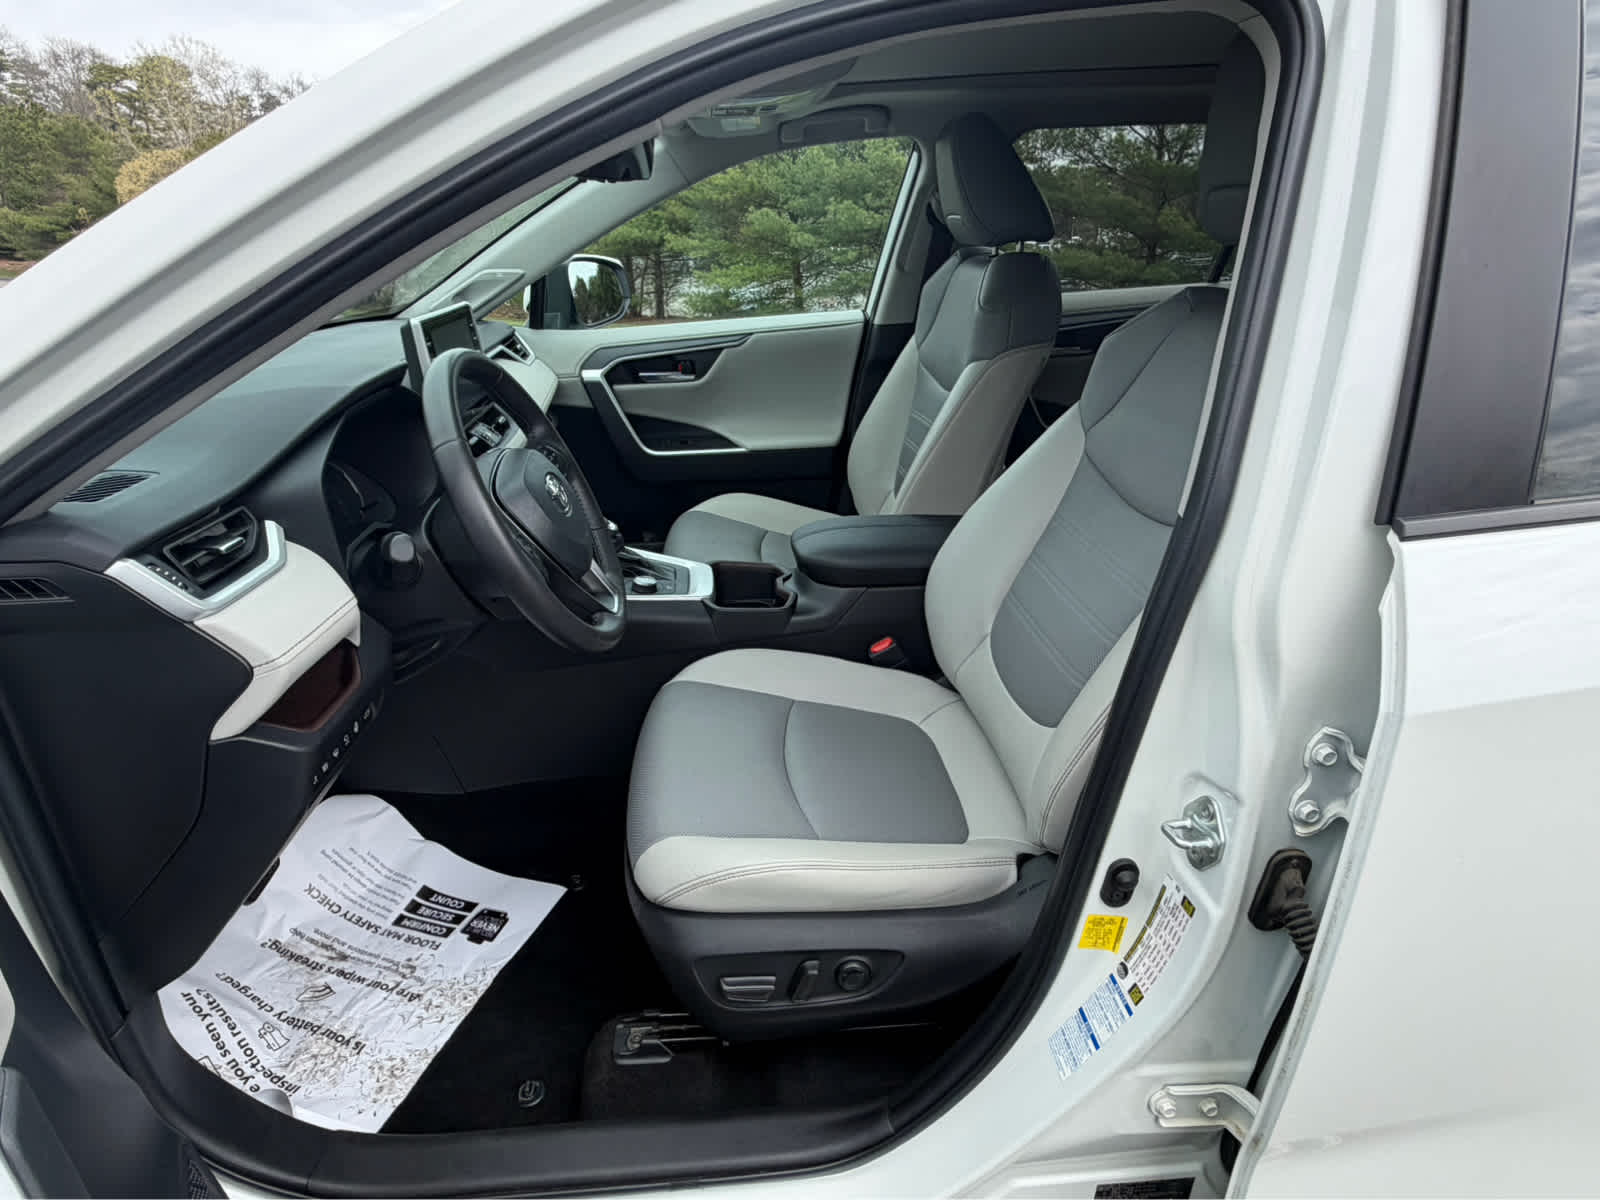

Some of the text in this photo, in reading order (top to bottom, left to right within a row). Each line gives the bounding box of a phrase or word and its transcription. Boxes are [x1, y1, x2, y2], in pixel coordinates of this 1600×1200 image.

[303, 883, 342, 914] CHECK
[429, 892, 465, 909] COUNT
[339, 910, 382, 934] SAFETY
[416, 905, 455, 922] SECURE
[379, 928, 404, 943] MAT
[400, 917, 448, 936] CONFIRM
[470, 920, 500, 933] NEVER
[403, 933, 442, 951] FLOOR
[260, 939, 326, 971] streaking?
[326, 965, 366, 985] wipers
[180, 992, 212, 1022] your
[396, 989, 420, 1003] Are
[215, 972, 366, 1055] Is your battery charged?
[196, 988, 301, 1096] inspection results?
[205, 1022, 231, 1059] seen
[226, 1058, 255, 1086] you
